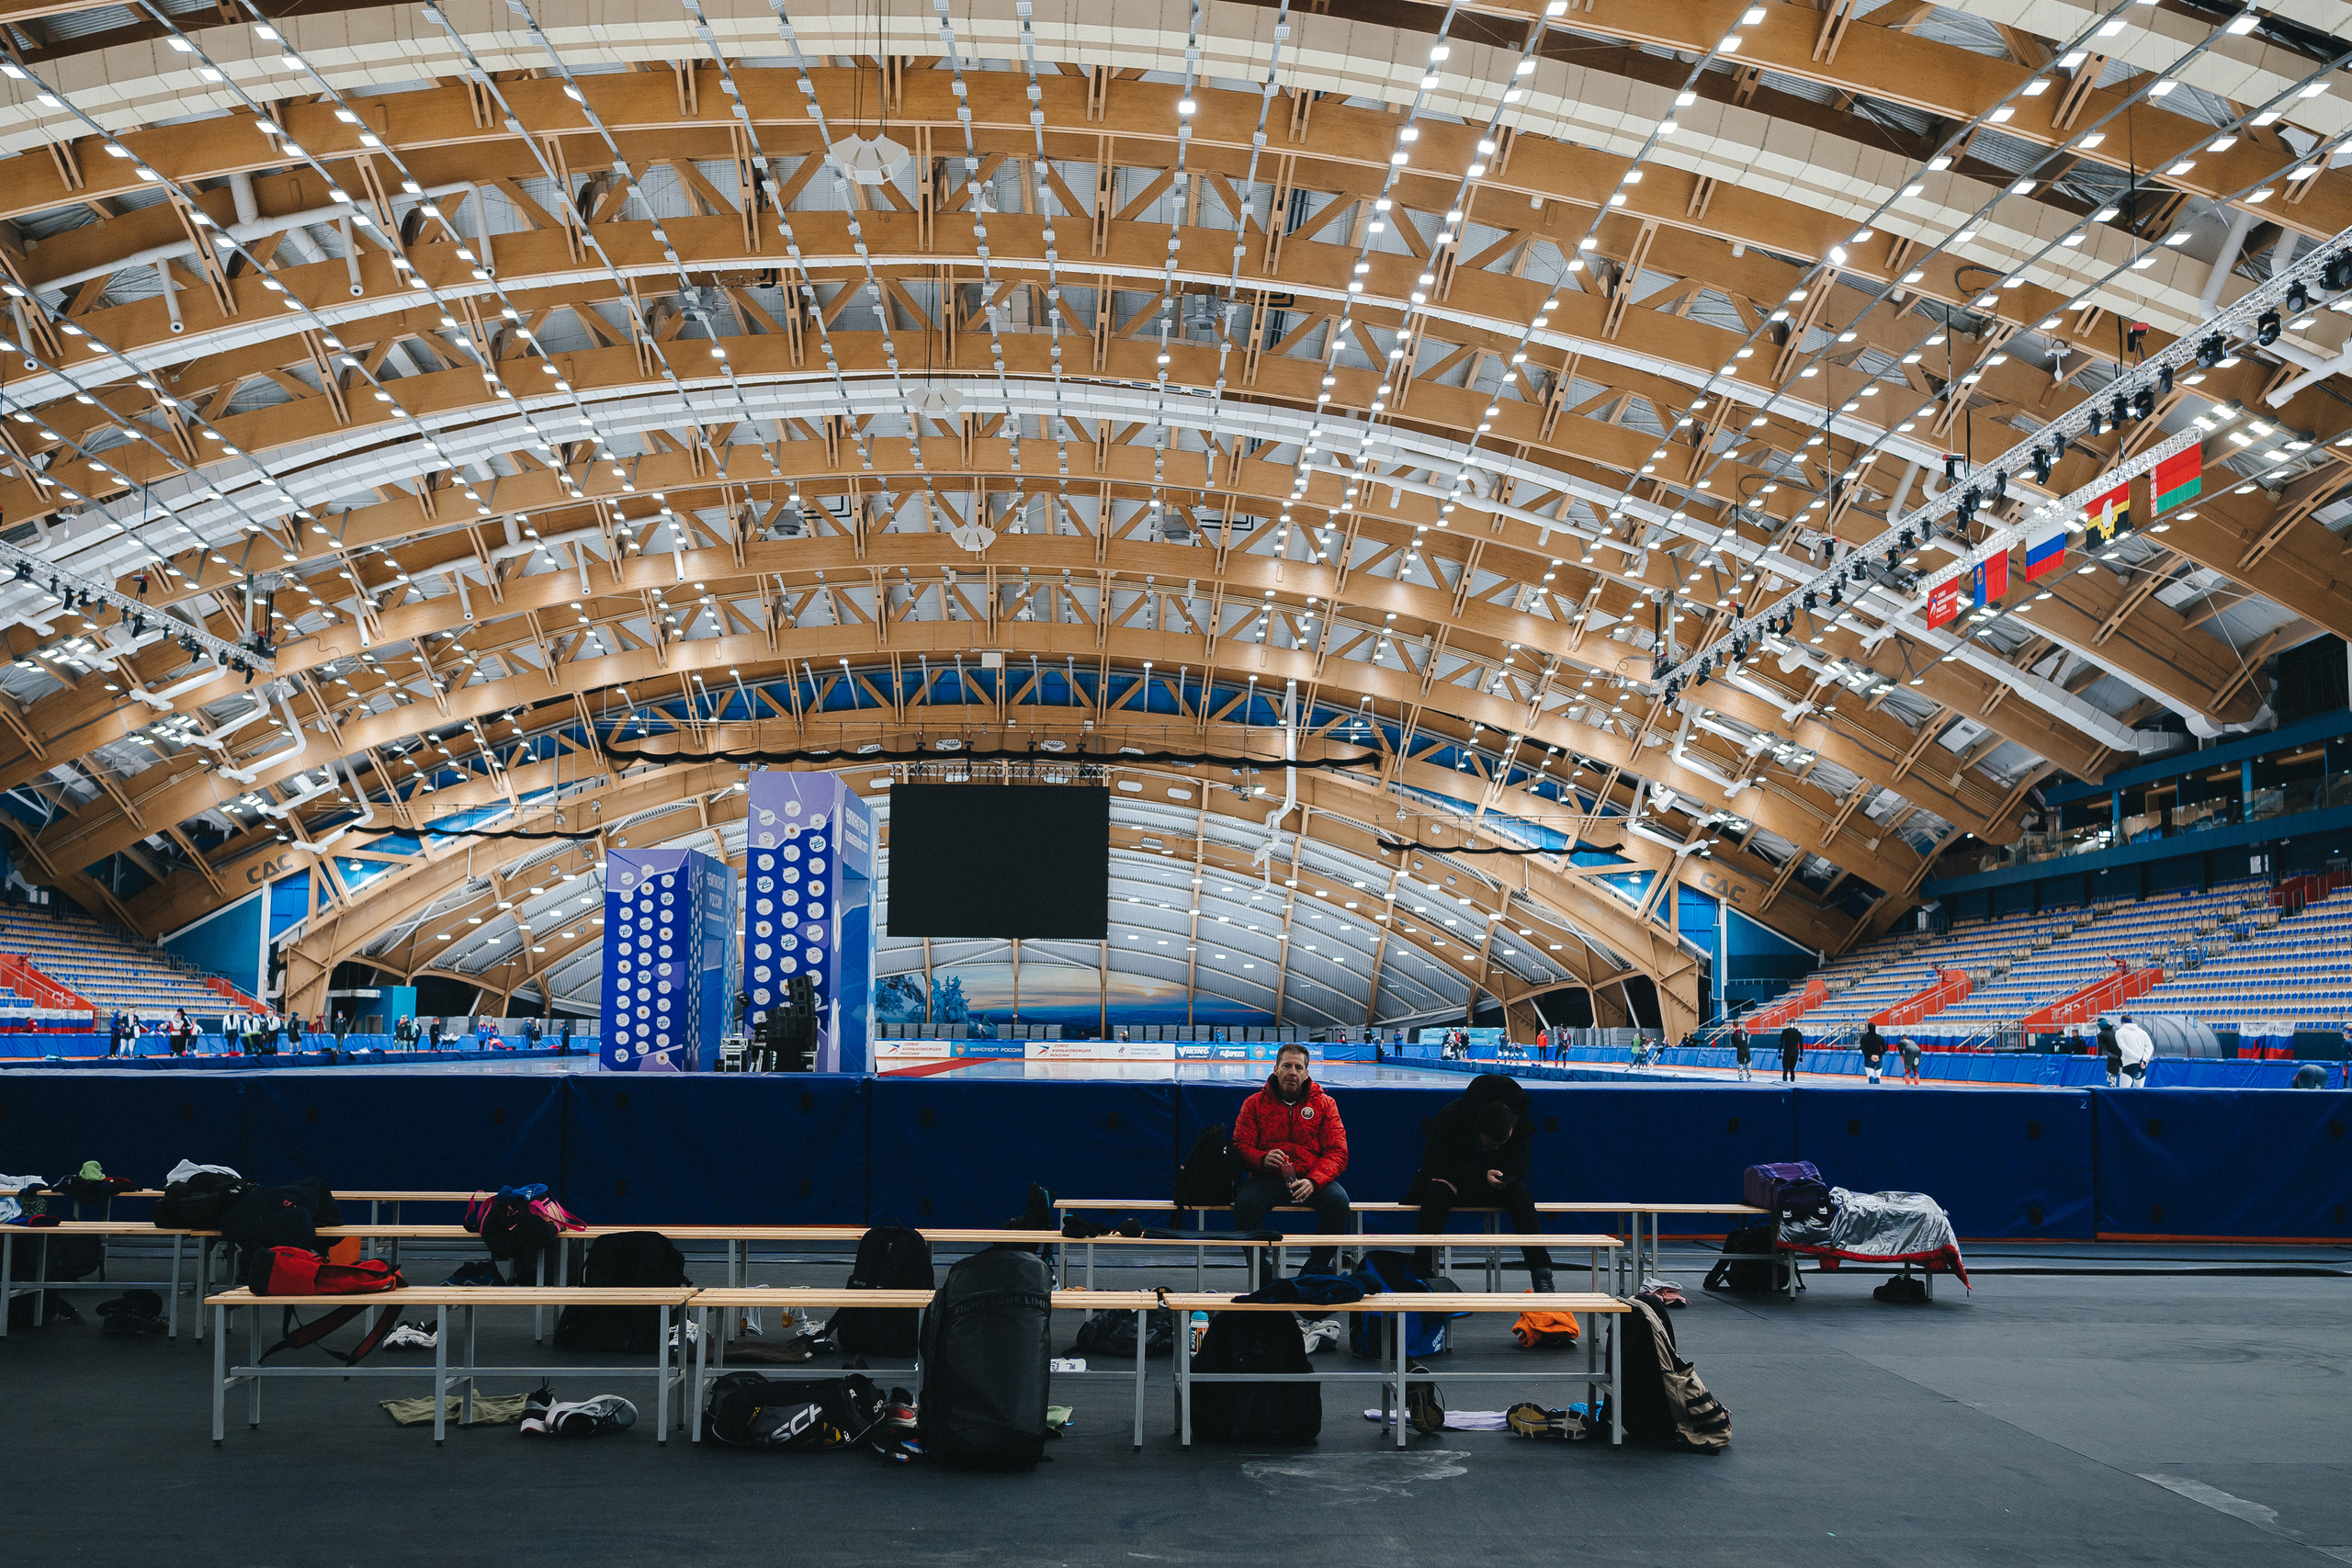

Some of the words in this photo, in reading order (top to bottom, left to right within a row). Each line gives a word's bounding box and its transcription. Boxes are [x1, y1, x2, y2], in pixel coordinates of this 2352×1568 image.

[1176, 1046, 1211, 1057] VIKING
[1219, 1049, 1246, 1058] K4SPEED
[2080, 1099, 2087, 1110] 2
[955, 1299, 985, 1315] FIGHT
[990, 1295, 1022, 1306] YOUR
